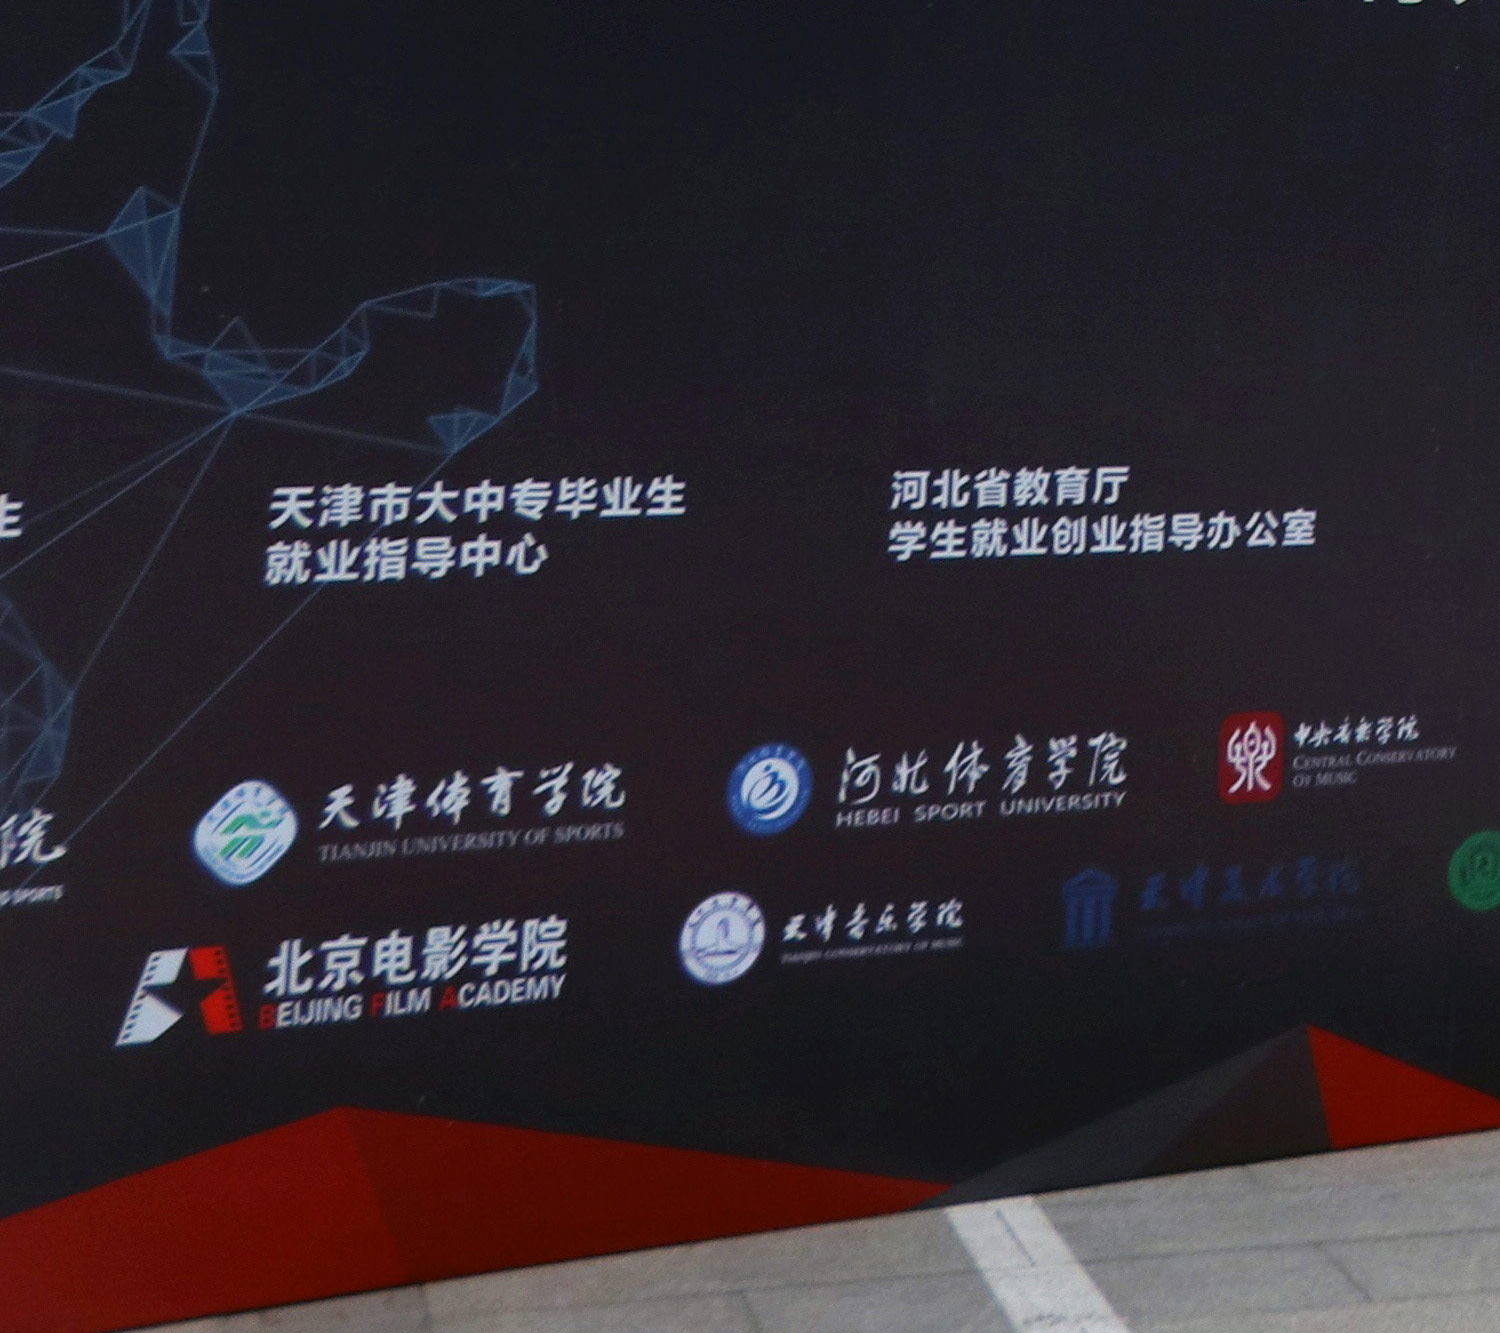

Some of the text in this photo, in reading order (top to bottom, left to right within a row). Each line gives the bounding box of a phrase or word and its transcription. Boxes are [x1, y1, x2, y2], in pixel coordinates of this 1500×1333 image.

[268, 473, 688, 530] 天津市大中专毕业生
[889, 465, 1131, 510] 河北省教育厅
[263, 533, 550, 586] 就业指导中心
[887, 507, 1318, 562] 学生就业创业指导办公室
[319, 760, 627, 831] 天津体育学院
[836, 731, 1129, 805] 河北体育学院
[834, 789, 1127, 829] HEBEI SPORT UNIVERSITY
[317, 821, 625, 864] TIANJIN UNIVERSITY OF SPORTS
[261, 913, 568, 997] 北京电影学院
[257, 972, 567, 1030] BEIJING FILM ACADEMY
